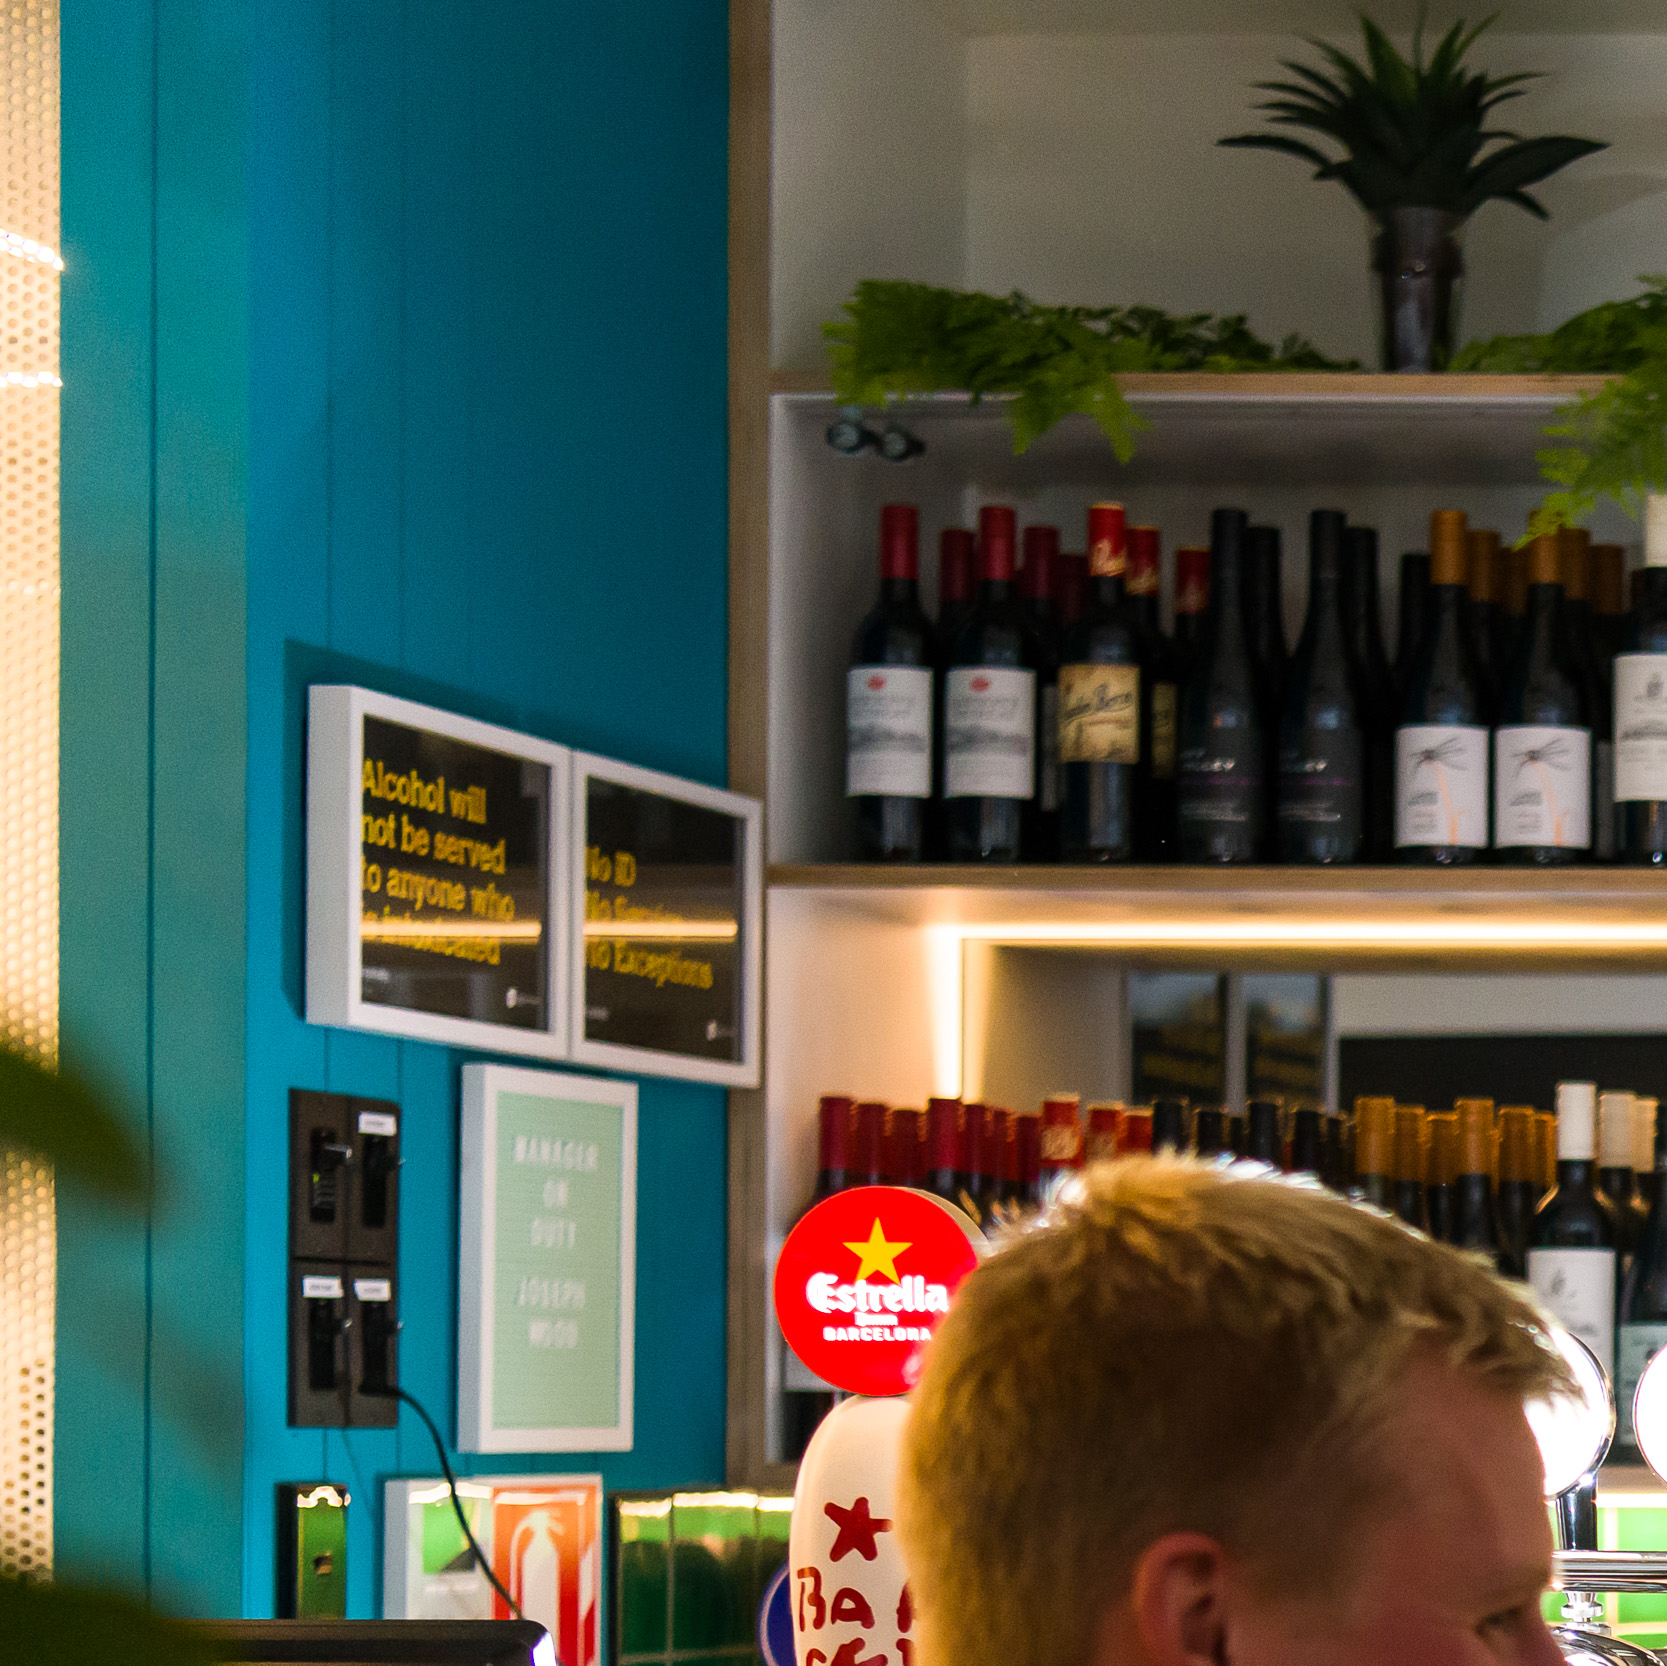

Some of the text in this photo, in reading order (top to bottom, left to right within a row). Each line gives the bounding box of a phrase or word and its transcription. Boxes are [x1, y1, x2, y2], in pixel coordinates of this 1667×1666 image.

[362, 758, 487, 824] Alcohol will
[362, 811, 506, 875] not be served
[586, 845, 637, 887] No ID
[386, 867, 467, 911] anyone
[470, 882, 516, 922] who
[613, 939, 714, 990] Exceptions
[806, 1272, 949, 1313] Estrella
[823, 1327, 932, 1341] BARCELONA
